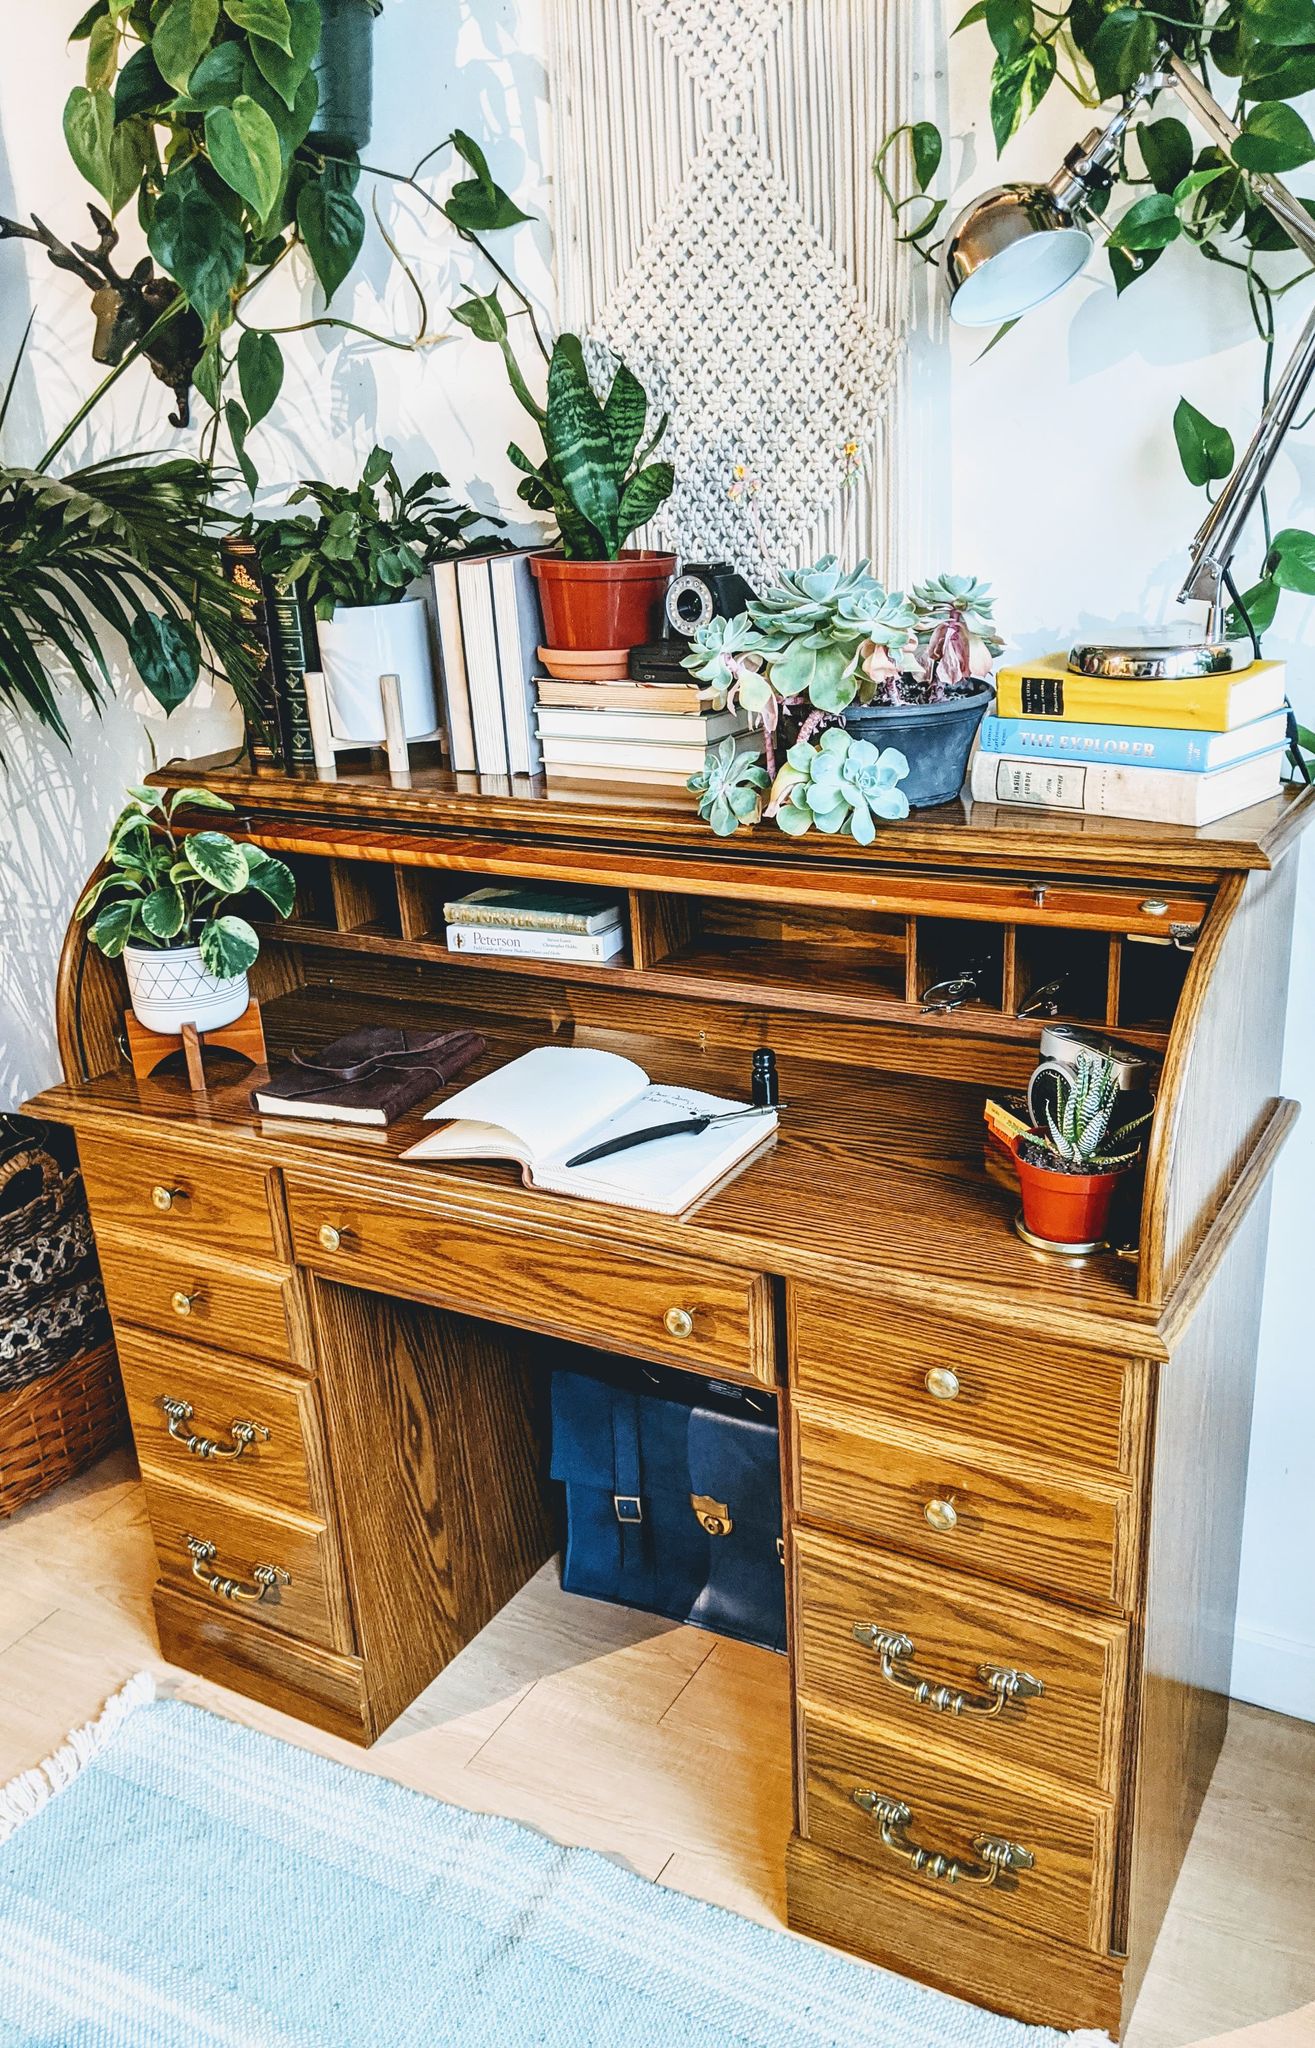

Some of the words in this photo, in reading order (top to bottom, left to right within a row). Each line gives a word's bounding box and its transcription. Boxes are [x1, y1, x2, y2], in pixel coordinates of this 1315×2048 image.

[1019, 731, 1054, 748] THE
[1059, 735, 1156, 758] EXPLORER
[1013, 770, 1021, 794] INSIDE
[1024, 771, 1032, 795] EUROPE
[473, 931, 521, 947] Peterson
